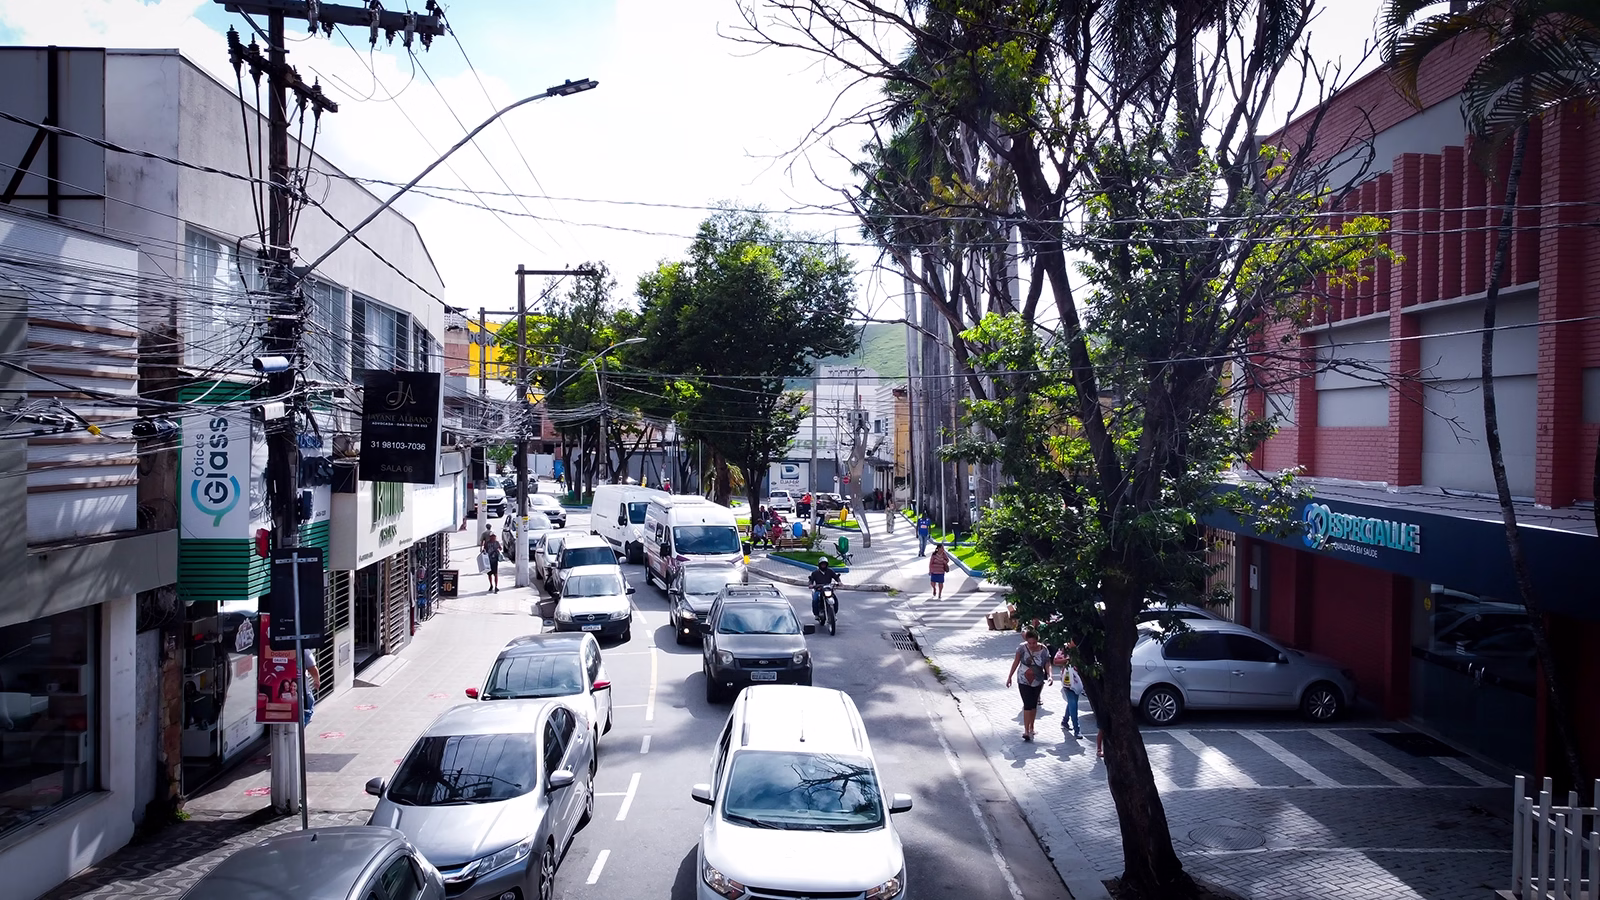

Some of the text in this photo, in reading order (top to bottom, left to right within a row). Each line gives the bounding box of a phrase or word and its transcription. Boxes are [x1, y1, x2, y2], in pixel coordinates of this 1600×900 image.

[367, 413, 432, 423] JAYANE ALBANO
[370, 440, 426, 450] 31 98103-7036
[192, 433, 204, 477] Óticas
[204, 417, 228, 504] Glass
[381, 464, 413, 473] SALA 06
[1329, 512, 1420, 553] ESPECIALLE
[1356, 544, 1363, 554] EM
[1363, 546, 1378, 558] SAÚDE
